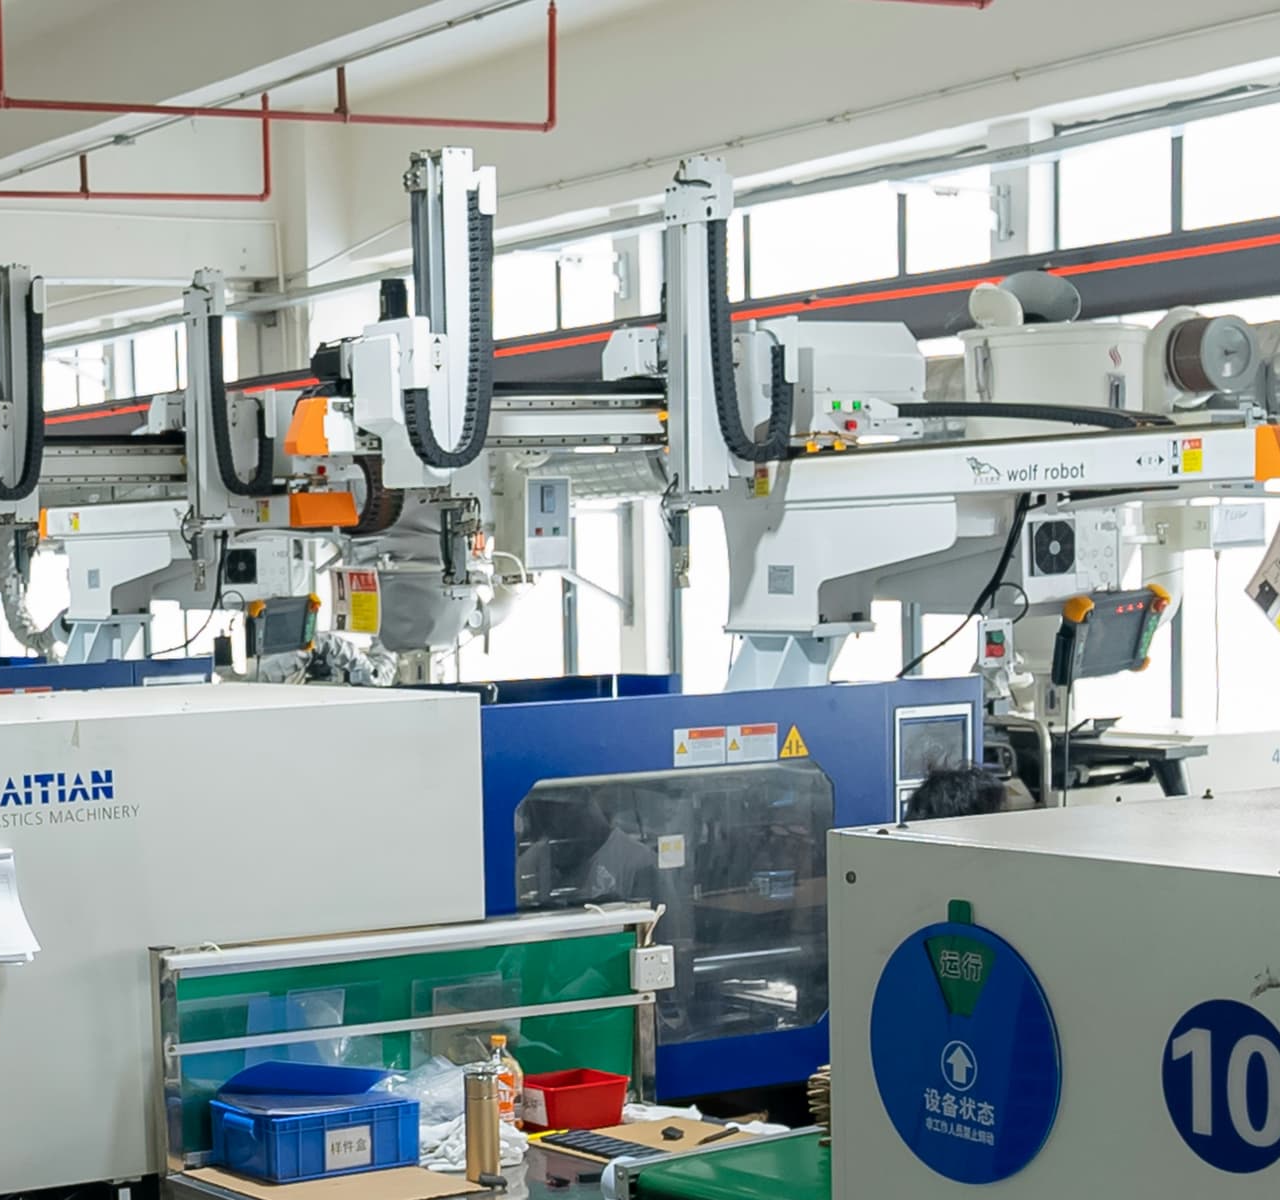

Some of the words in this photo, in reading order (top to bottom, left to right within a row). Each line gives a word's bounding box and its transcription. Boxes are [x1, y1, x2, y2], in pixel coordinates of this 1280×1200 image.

[1006, 463, 1038, 482] wolf
[1044, 461, 1085, 481] robot
[49, 804, 141, 825] MACHINERY
[939, 949, 983, 983] 运行
[923, 1087, 995, 1127] 设备状态
[330, 1138, 368, 1154] 样件盒
